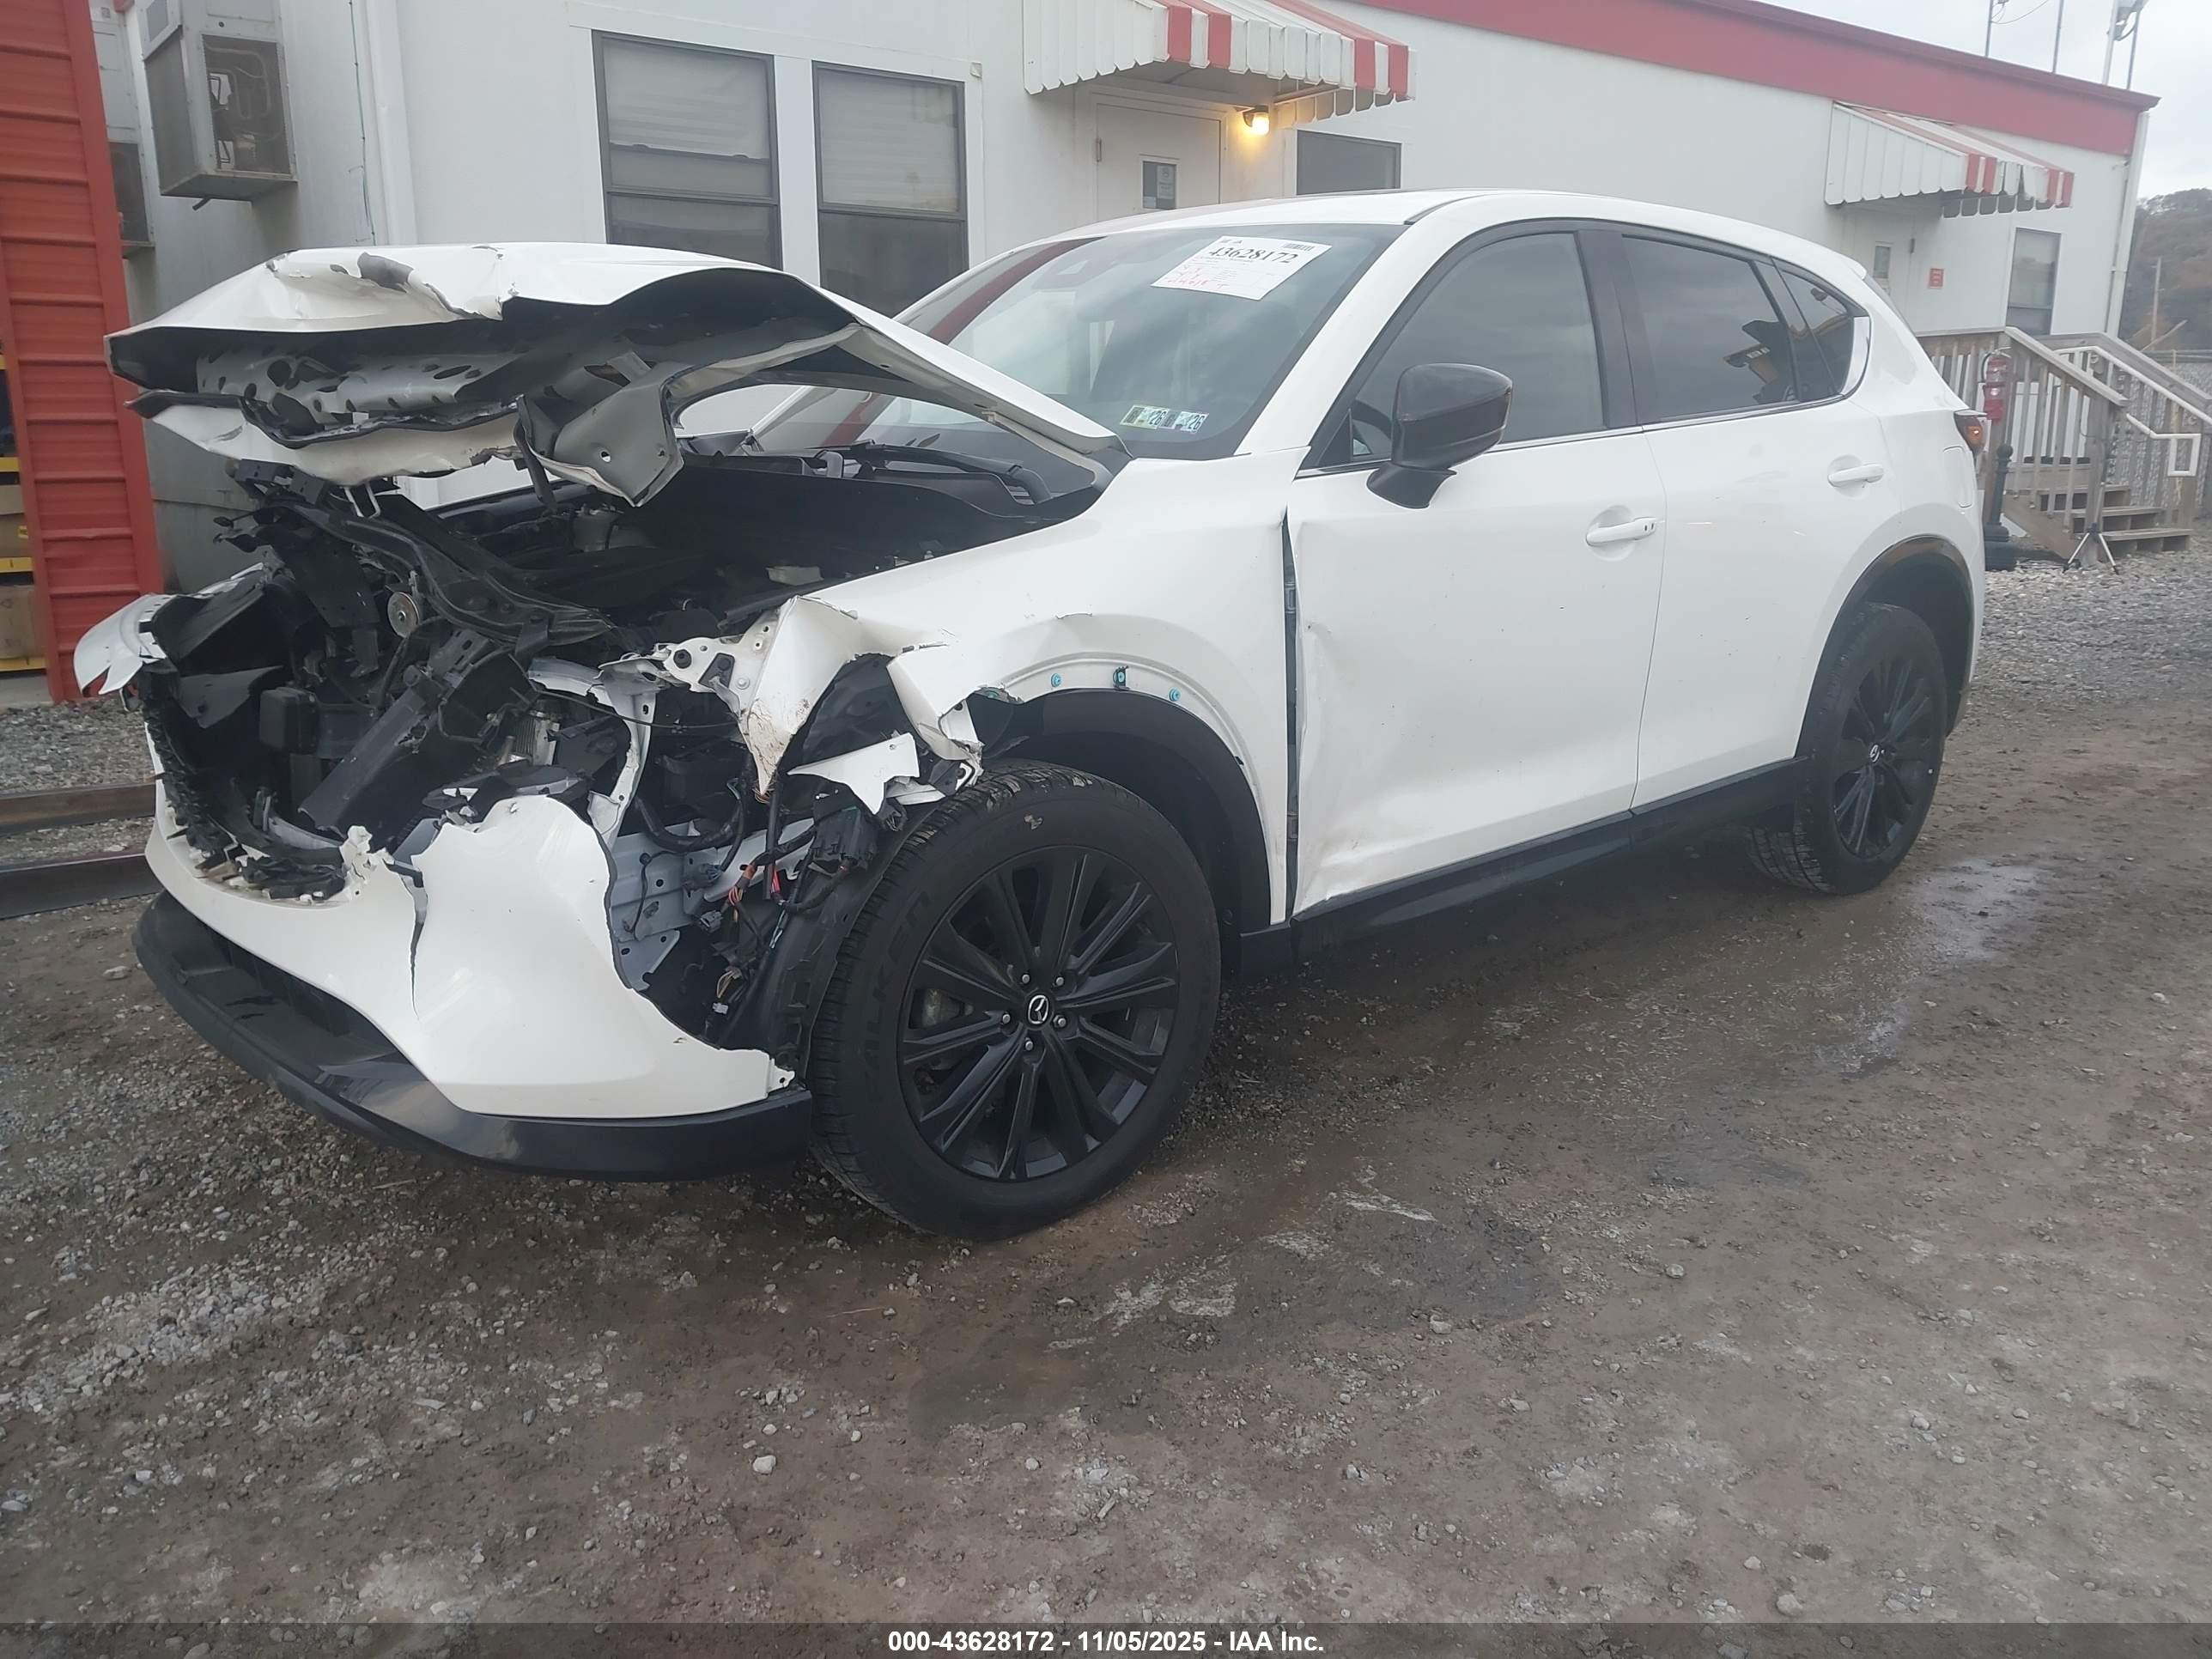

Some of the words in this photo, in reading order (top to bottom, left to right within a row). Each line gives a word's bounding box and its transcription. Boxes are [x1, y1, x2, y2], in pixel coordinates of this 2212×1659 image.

[1208, 246, 1299, 264] 43628172
[1148, 410, 1167, 426] 26
[1187, 414, 1206, 430] 26
